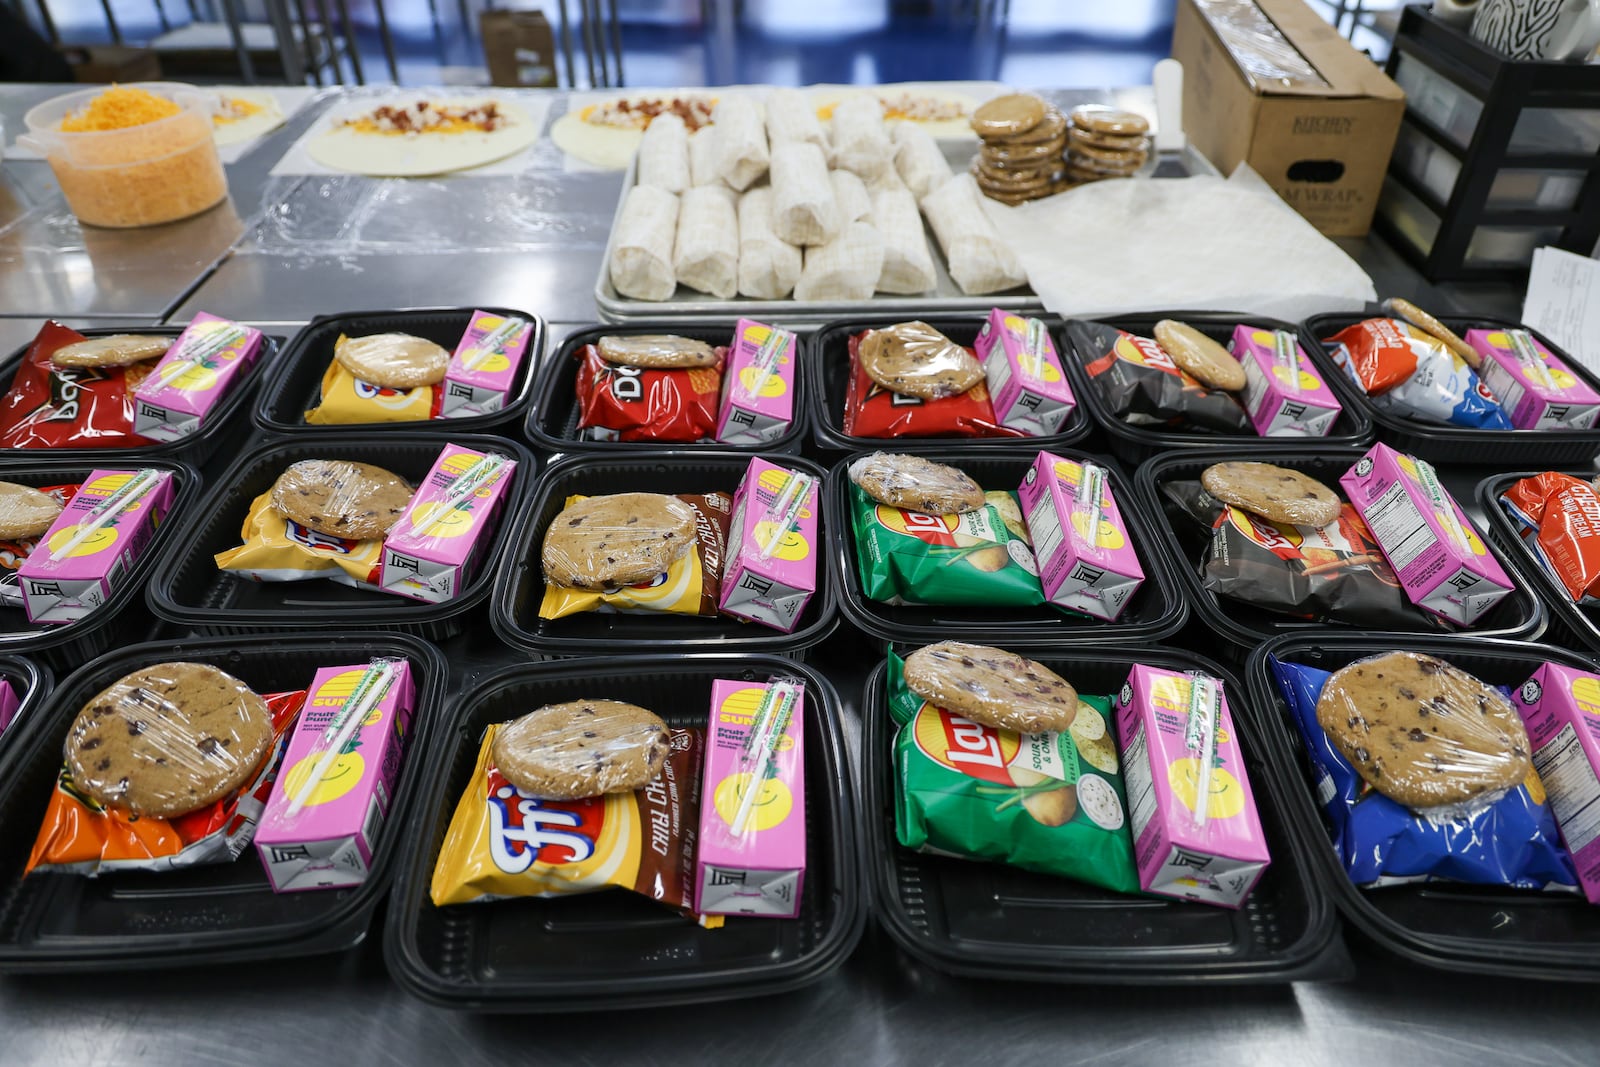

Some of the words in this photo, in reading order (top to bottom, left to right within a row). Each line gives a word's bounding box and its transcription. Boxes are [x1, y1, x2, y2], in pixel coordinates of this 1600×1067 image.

[1571, 482, 1600, 536] CHEDDA
[1569, 511, 1593, 538] CREAM
[1530, 739, 1557, 760] Nutrition
[1555, 725, 1571, 740] Facts
[1567, 742, 1580, 754] 100
[662, 758, 675, 780] CHIPS
[1031, 744, 1042, 770] SOUR
[667, 781, 679, 802] CORN
[650, 808, 670, 856] CHILI
